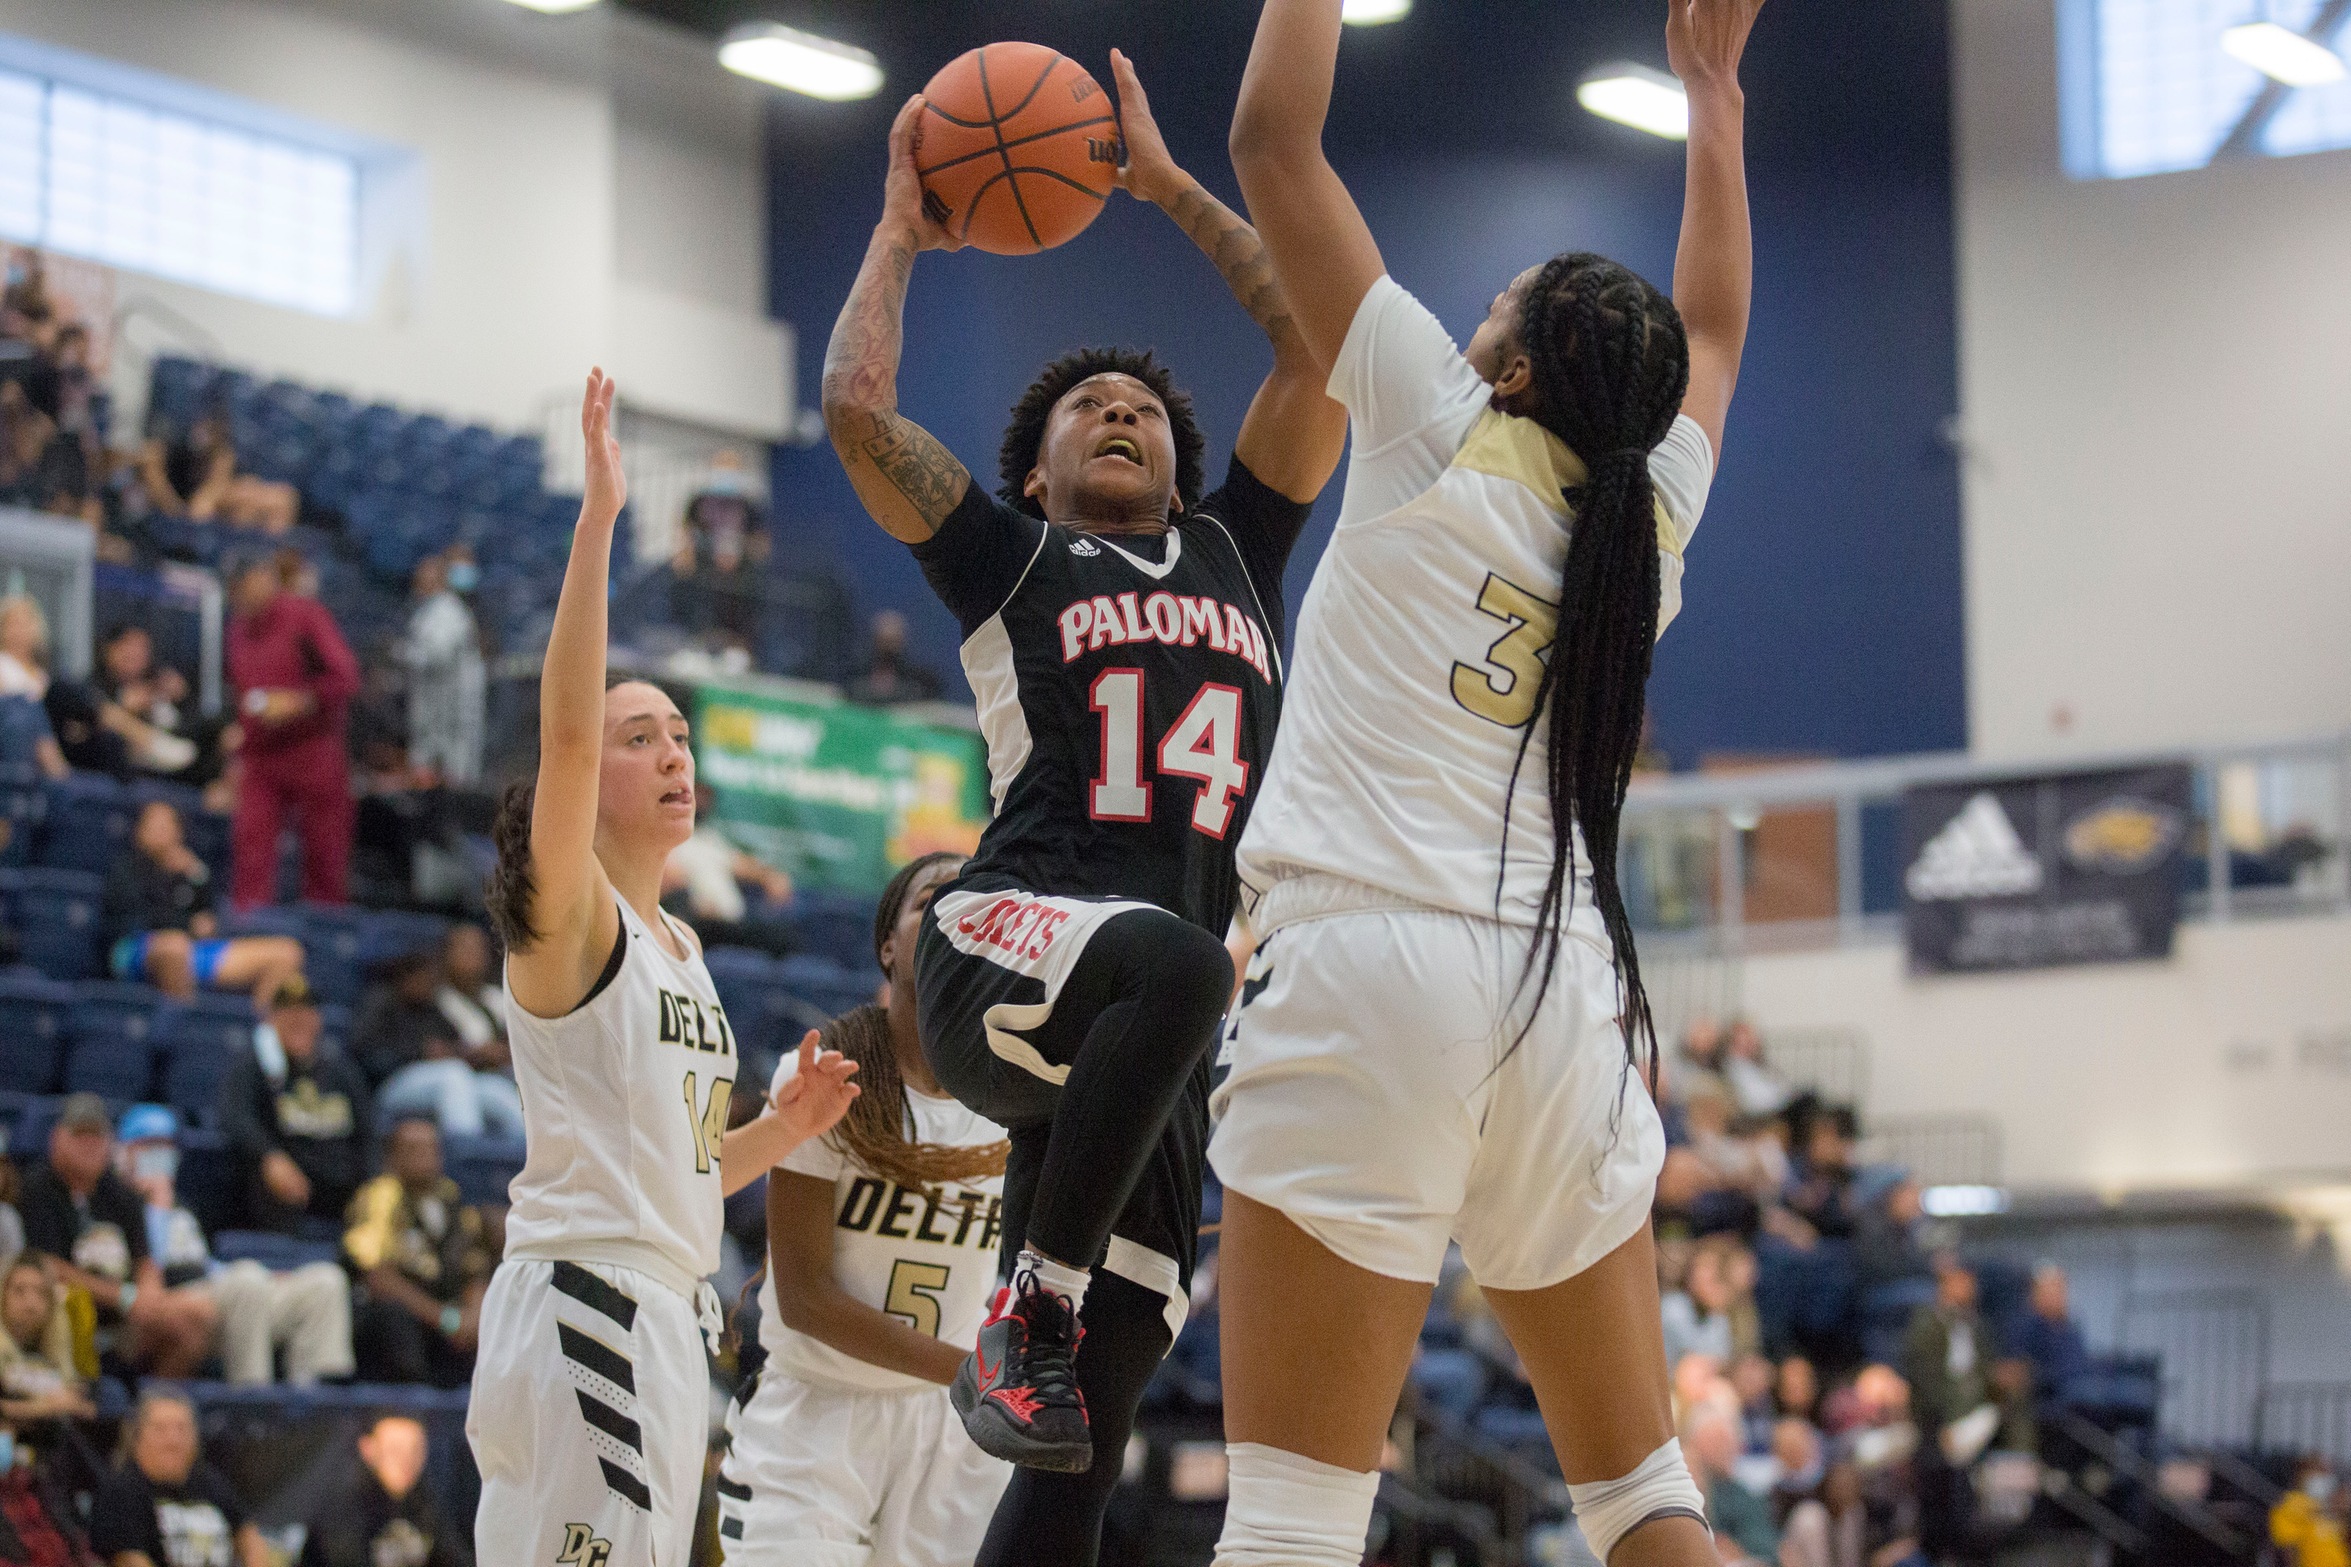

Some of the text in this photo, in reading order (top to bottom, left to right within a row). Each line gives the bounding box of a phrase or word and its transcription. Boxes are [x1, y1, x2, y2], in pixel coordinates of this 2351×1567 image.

[1057, 590, 1272, 686] PALOMAR
[1450, 570, 1560, 729] 3
[1089, 667, 1250, 841] 14
[658, 985, 731, 1057] DELT
[683, 1070, 733, 1175] 14
[884, 1258, 951, 1339] 5
